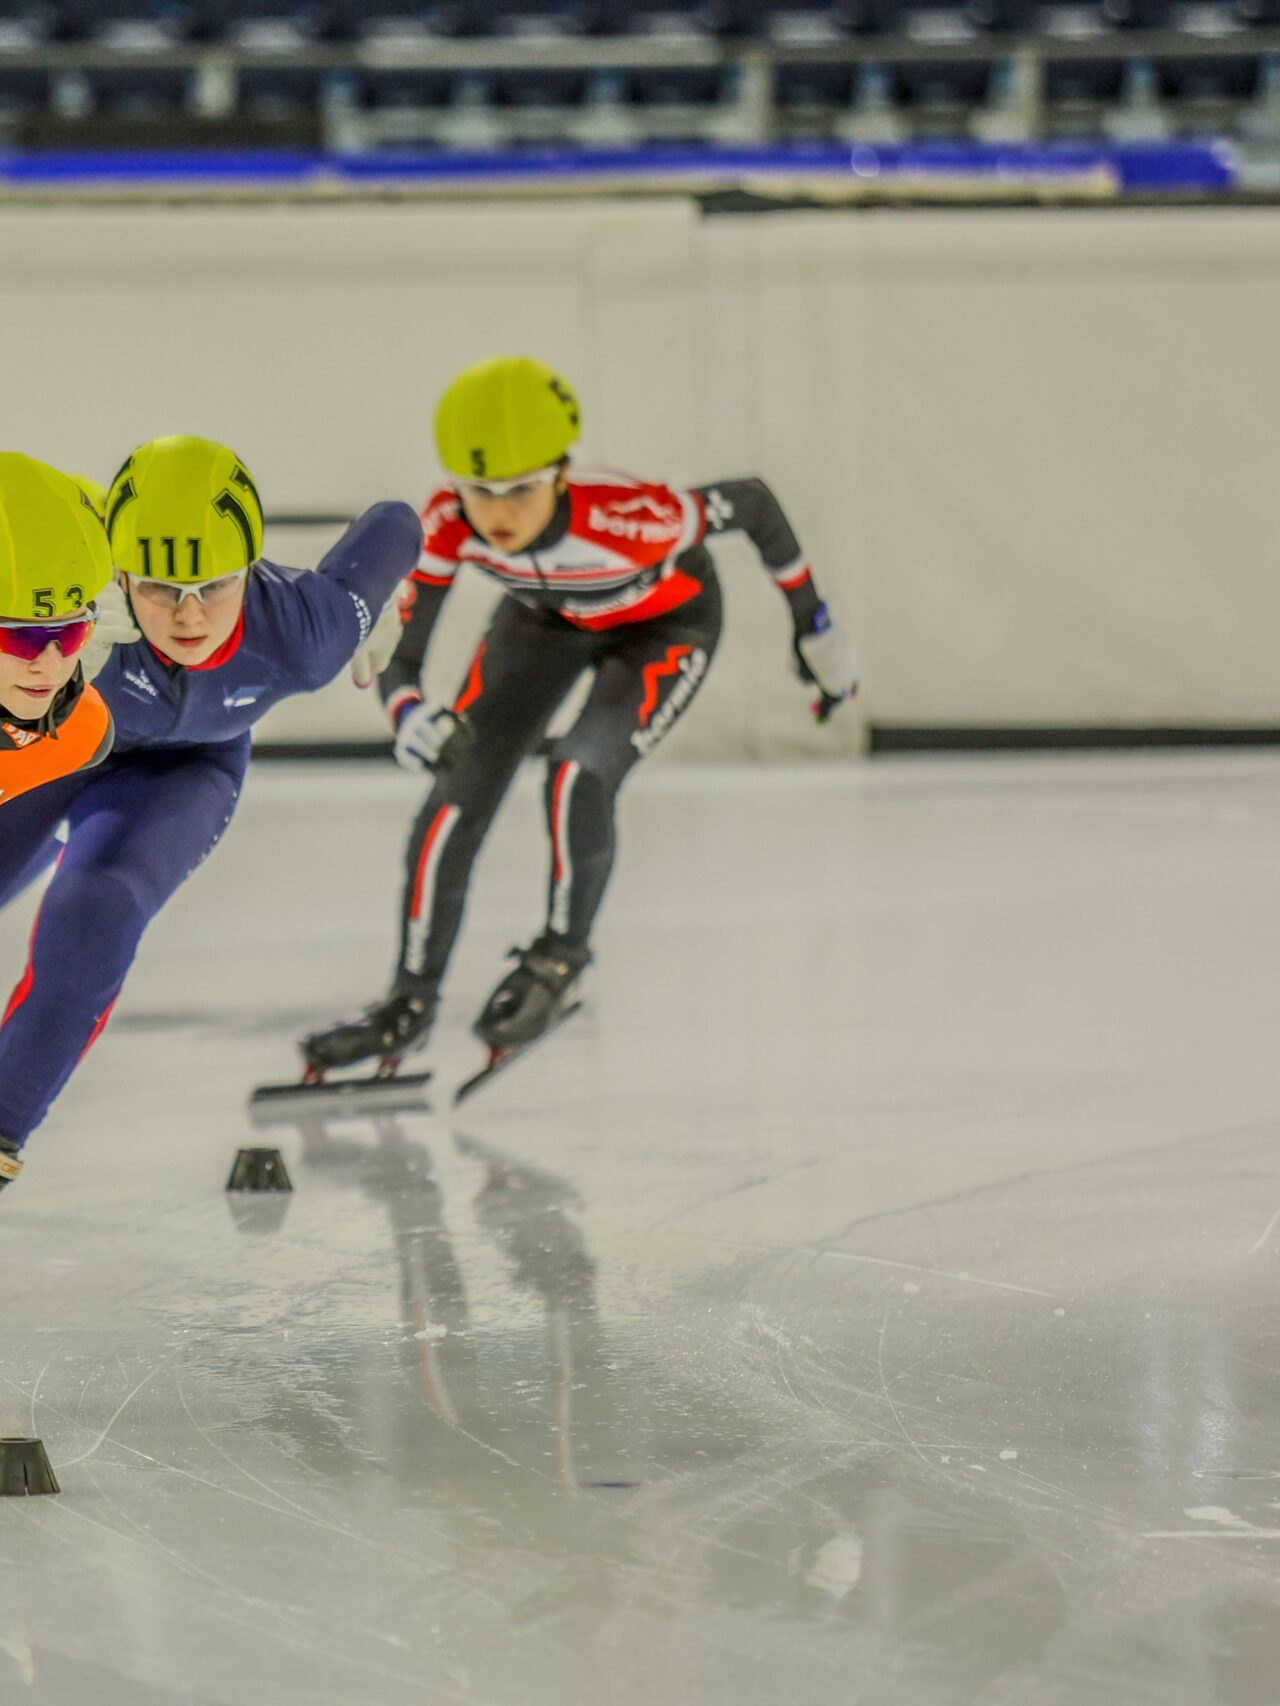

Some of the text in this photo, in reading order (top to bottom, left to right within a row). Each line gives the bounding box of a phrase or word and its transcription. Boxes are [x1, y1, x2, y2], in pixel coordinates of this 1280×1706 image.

[469, 446, 488, 479] 5
[137, 536, 201, 578] 111
[32, 584, 85, 618] 53
